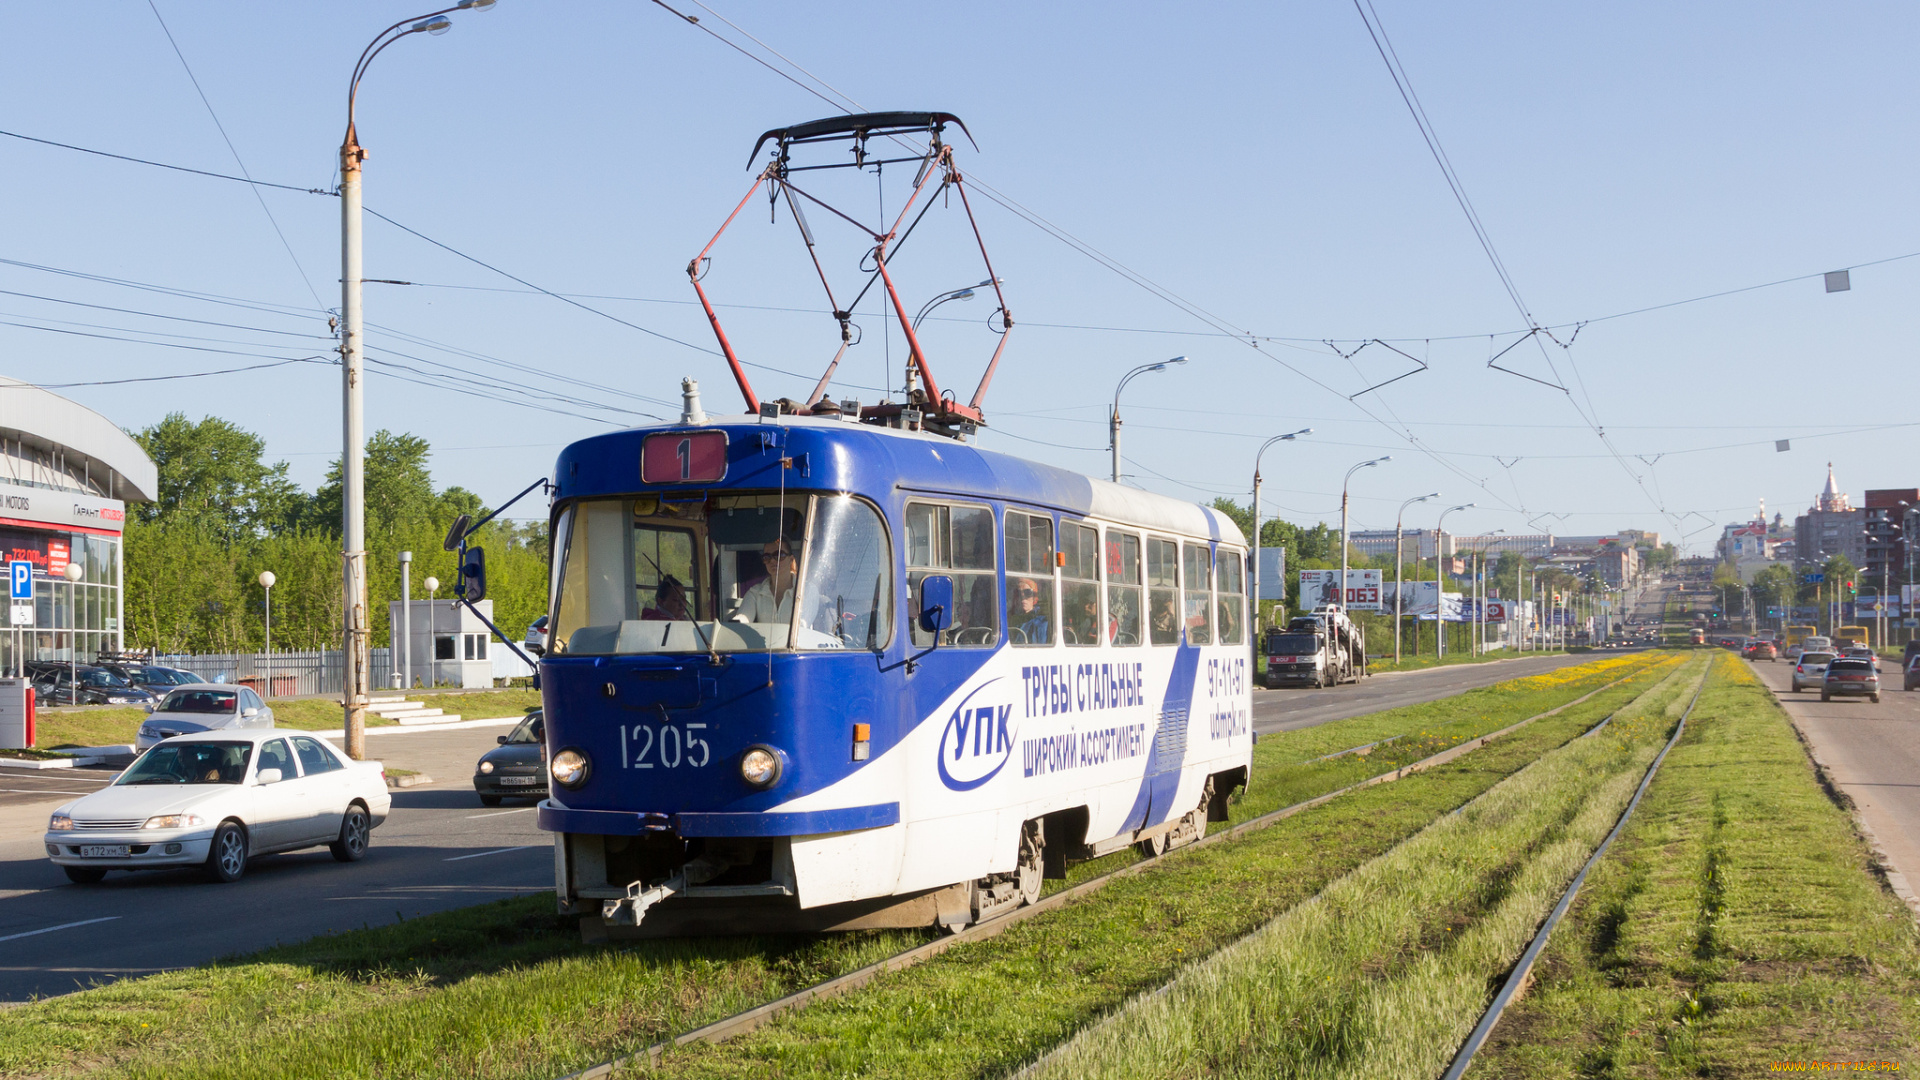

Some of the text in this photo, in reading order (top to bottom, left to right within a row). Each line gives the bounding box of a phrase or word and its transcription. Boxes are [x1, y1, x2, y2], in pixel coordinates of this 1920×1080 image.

[676, 438, 691, 480] 1
[5, 495, 30, 511] MOTORS
[15, 564, 29, 594] P
[661, 622, 671, 647] 1
[1022, 663, 1143, 718] ТРУБЫ СТАЛЬНЫЕ
[1208, 658, 1244, 698] 97-11-97
[953, 703, 1013, 761] УПК
[1210, 700, 1246, 747] udmpk.ru
[619, 723, 709, 769] 1205
[1023, 723, 1145, 778] ШИРОКИЙ АССОРТИМЕНТ
